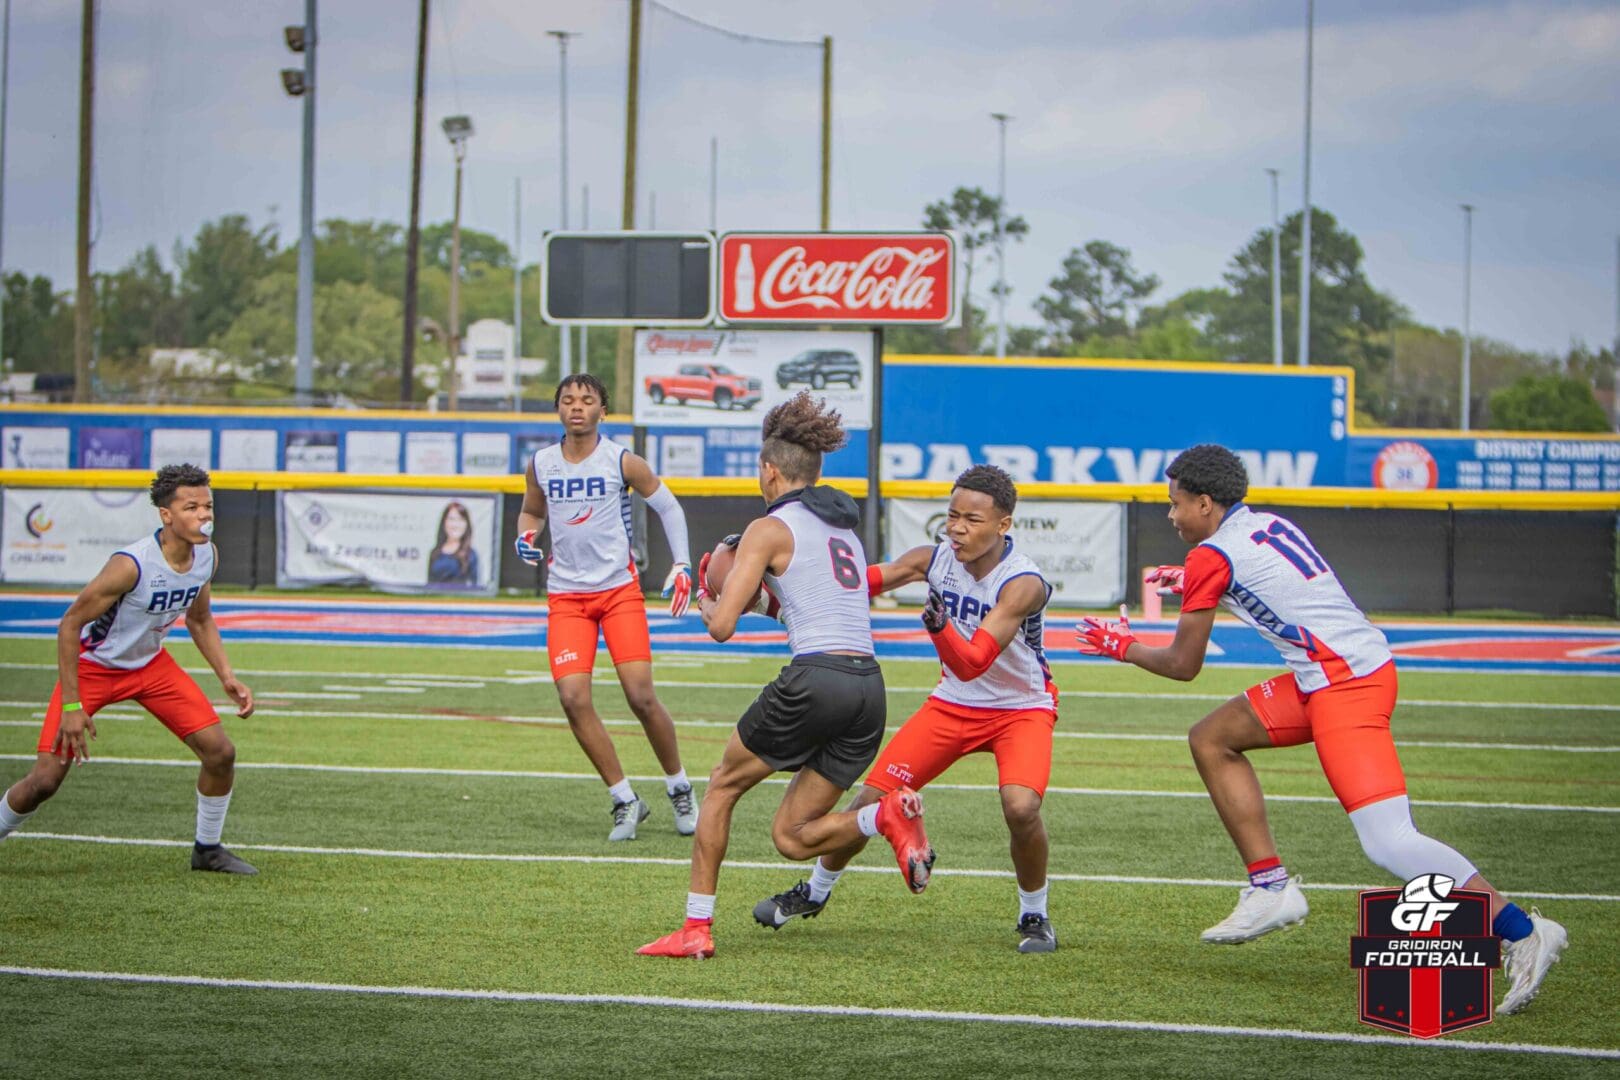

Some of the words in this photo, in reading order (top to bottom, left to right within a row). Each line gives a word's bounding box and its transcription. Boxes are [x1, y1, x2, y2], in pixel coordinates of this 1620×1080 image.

[759, 246, 946, 310] Coca-Cola
[1475, 440, 1545, 459] DISTRICT
[880, 443, 1319, 487] PARKVW
[548, 477, 606, 498] RPA
[397, 546, 421, 561] MD
[1250, 519, 1329, 581] 11
[828, 536, 862, 591] 6
[146, 585, 201, 612] RPA
[1260, 680, 1274, 699] LITE
[886, 763, 914, 783] ELITE
